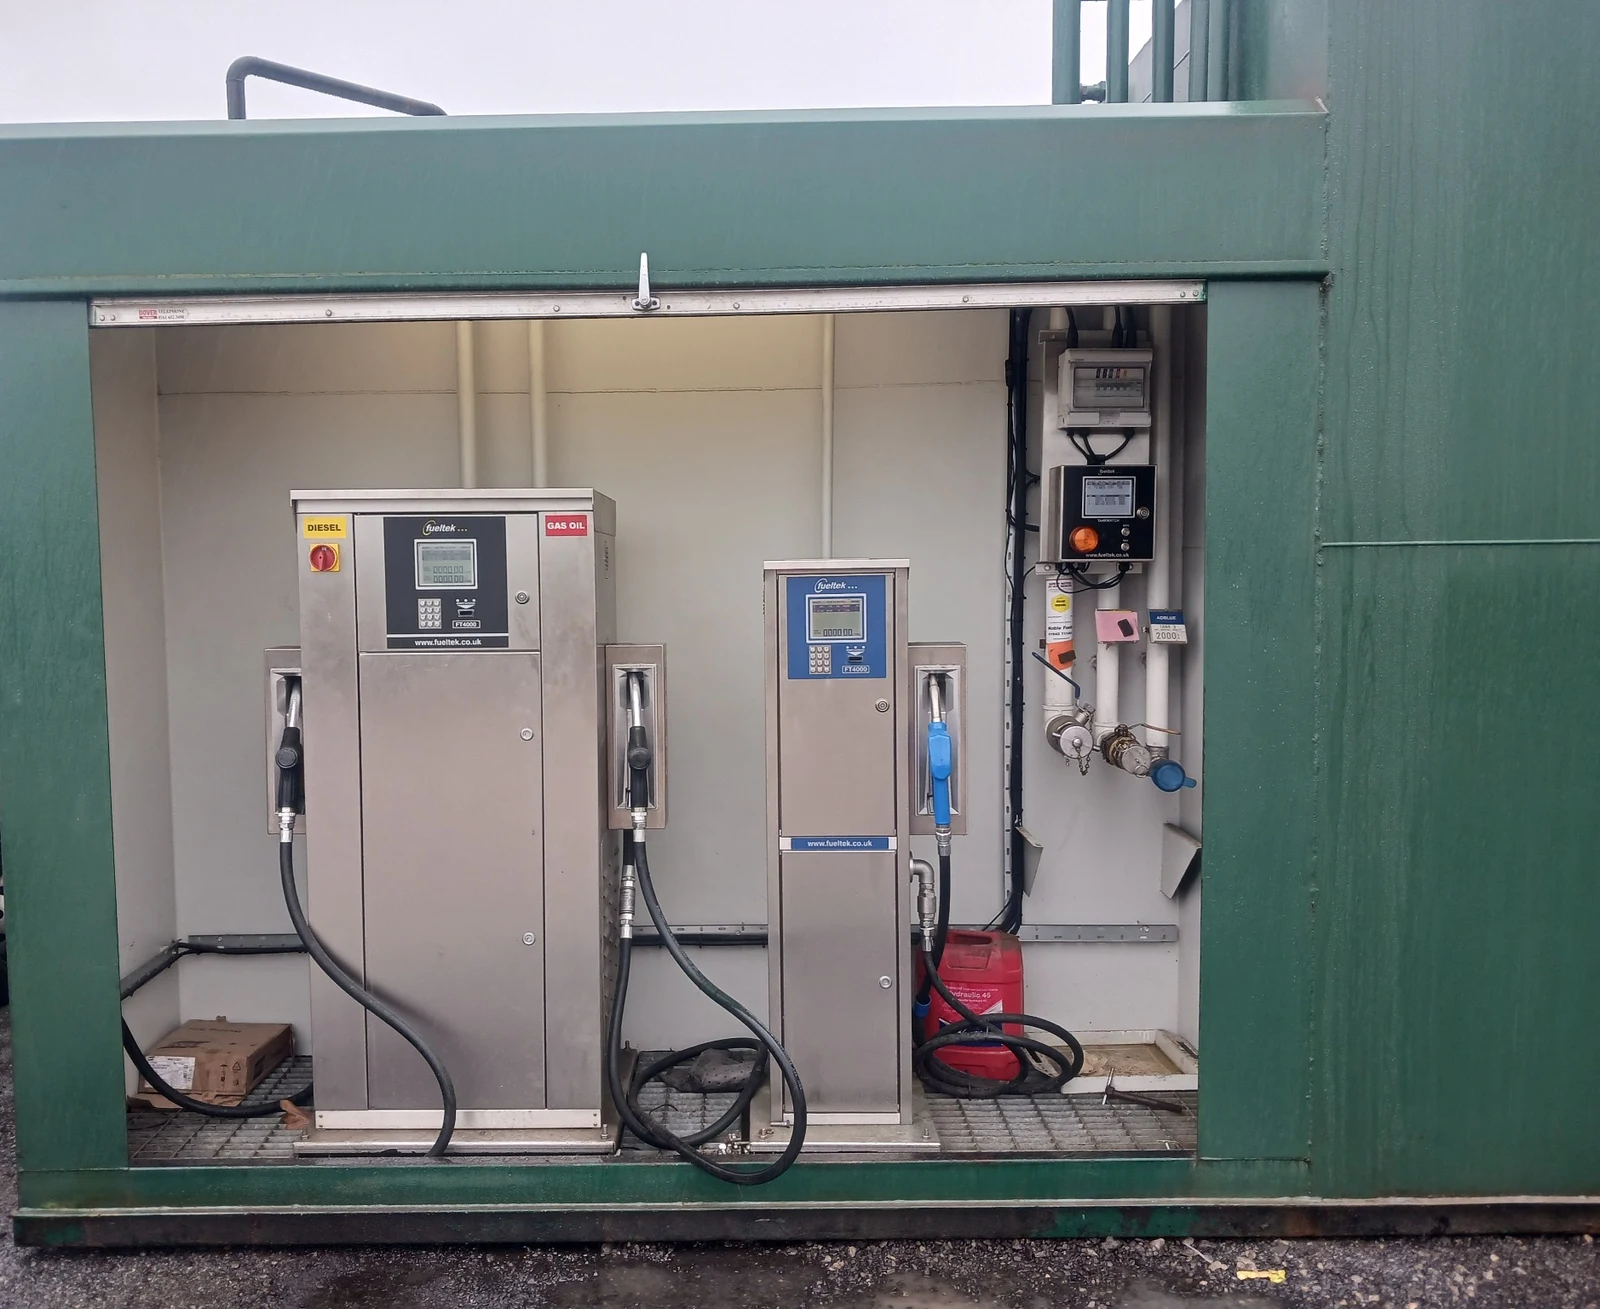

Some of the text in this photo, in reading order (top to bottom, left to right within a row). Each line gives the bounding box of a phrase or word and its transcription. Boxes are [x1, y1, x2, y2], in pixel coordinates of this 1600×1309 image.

[424, 521, 456, 533] fueltek
[547, 522, 567, 530] GAS
[814, 579, 846, 592] fueltek
